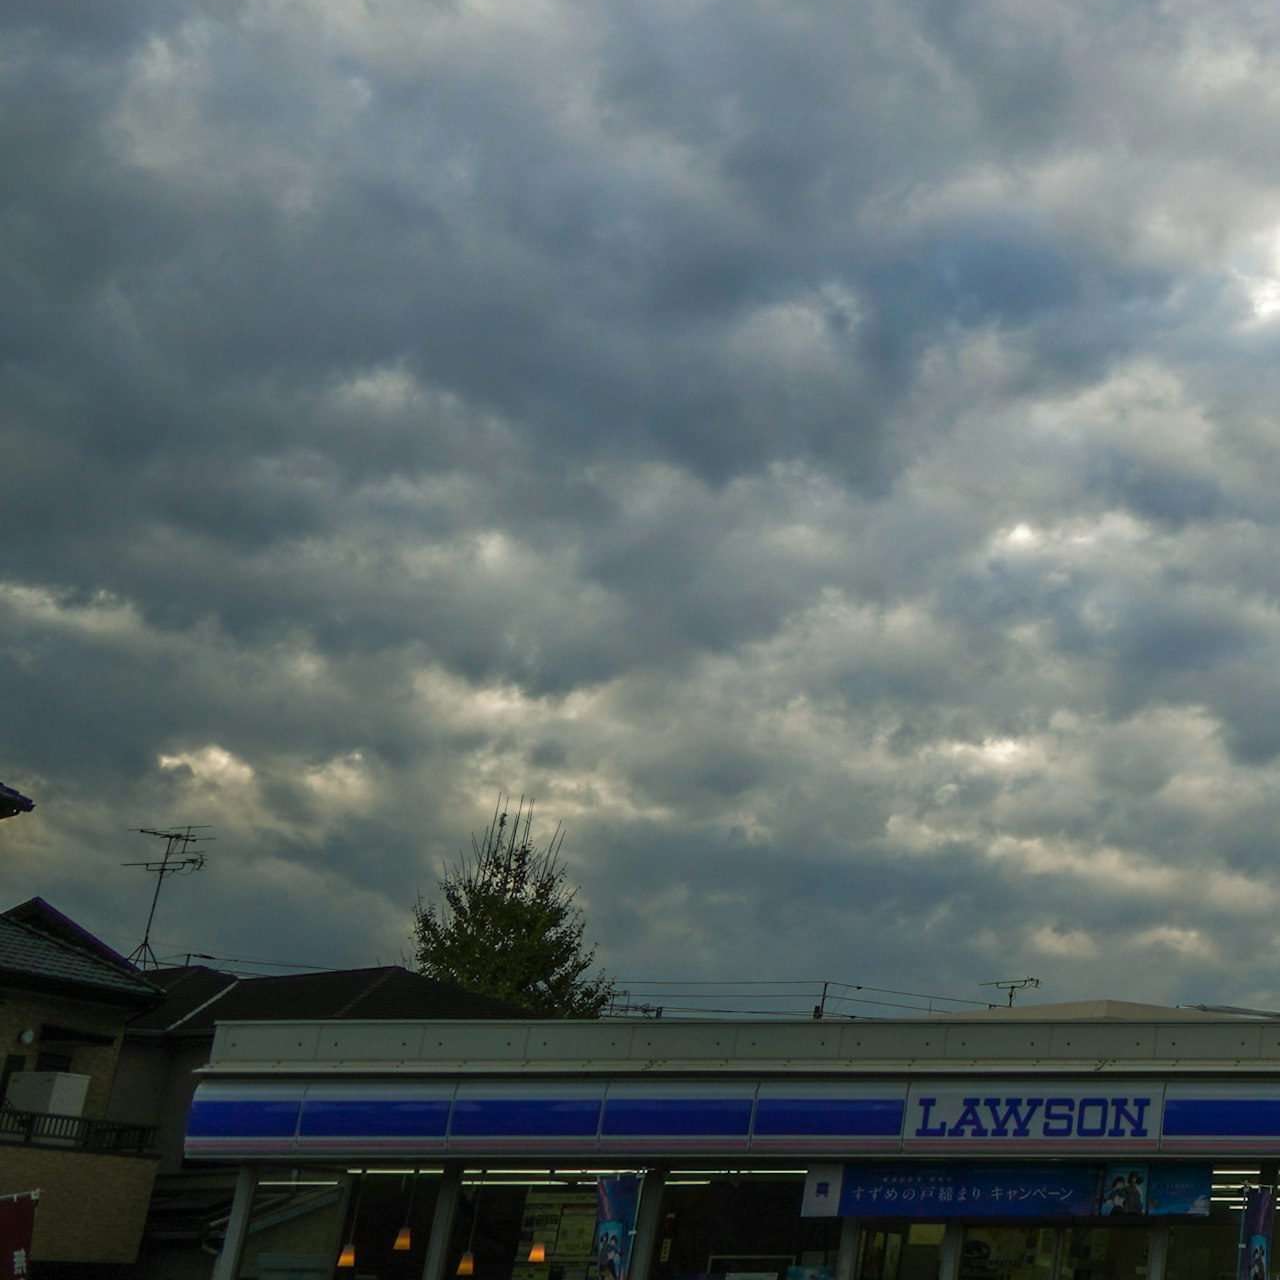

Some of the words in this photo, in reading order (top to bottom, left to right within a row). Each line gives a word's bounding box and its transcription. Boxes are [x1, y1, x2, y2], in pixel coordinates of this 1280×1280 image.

[916, 1098, 1150, 1137] LAWSON
[852, 1186, 981, 1201] すずめの戸締まり
[990, 1186, 1073, 1200] キャンペーン
